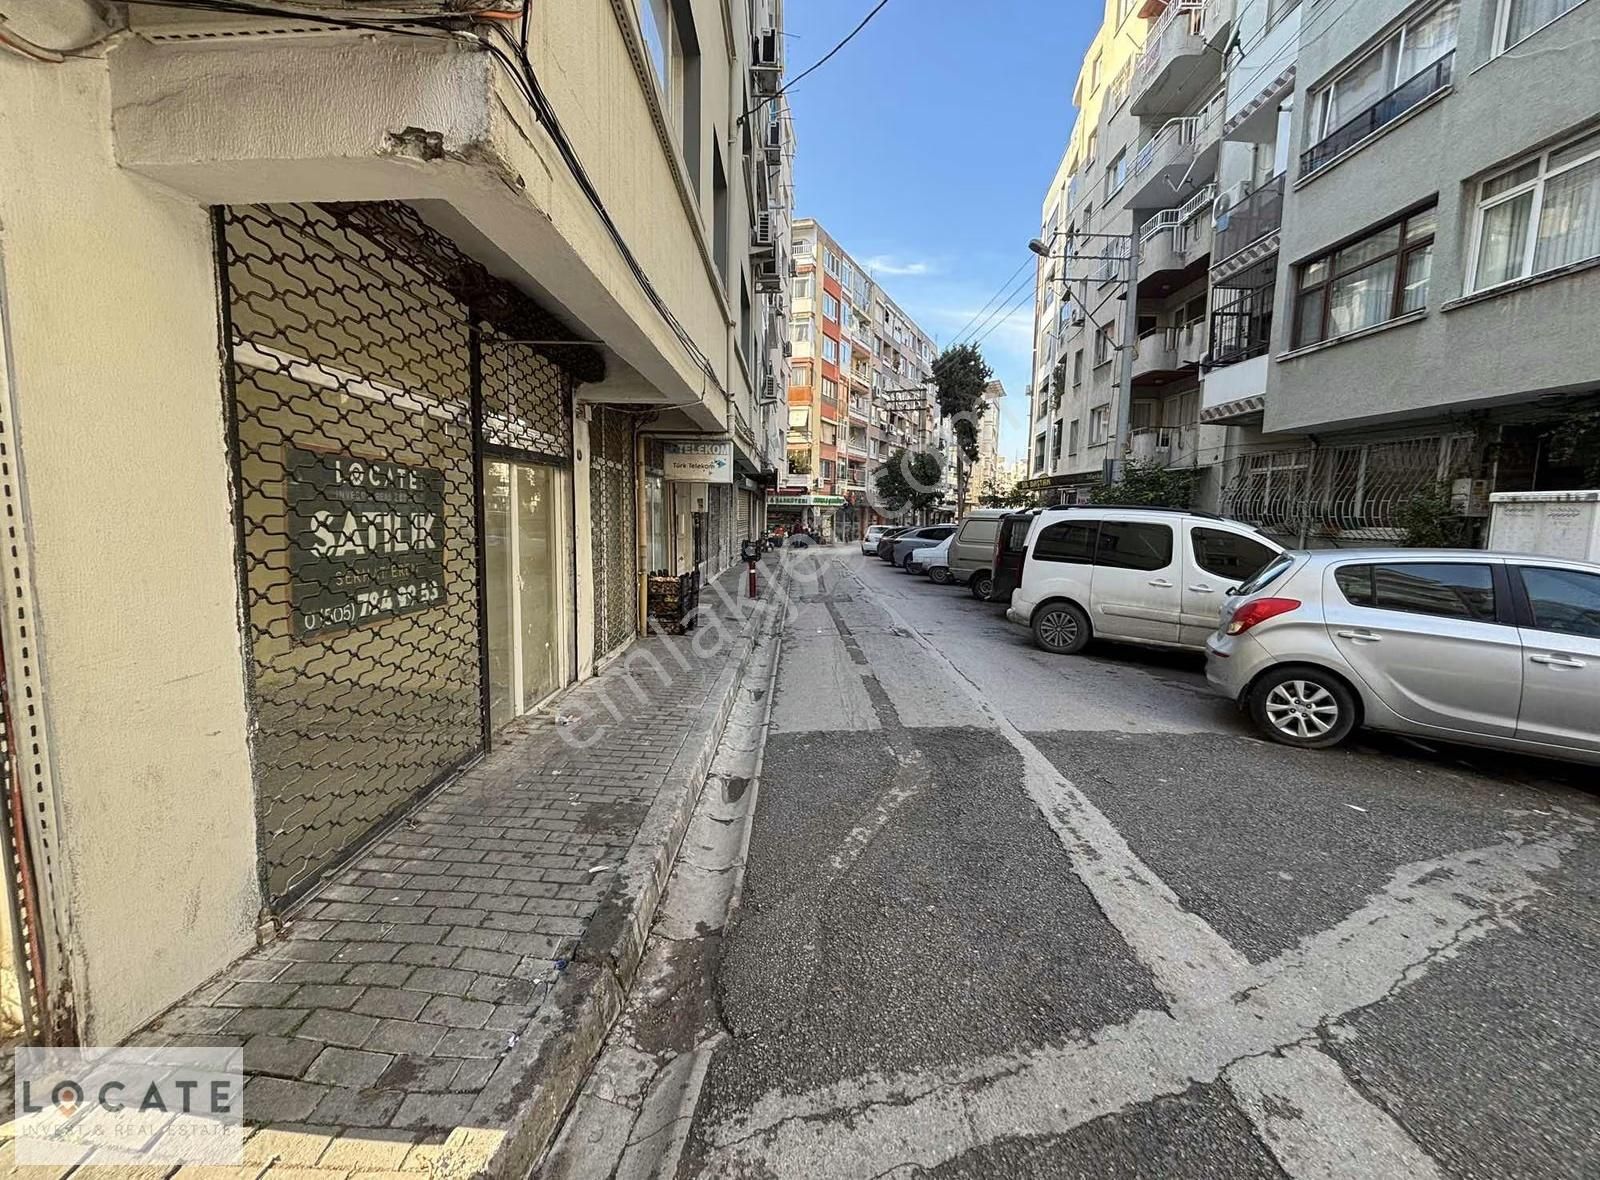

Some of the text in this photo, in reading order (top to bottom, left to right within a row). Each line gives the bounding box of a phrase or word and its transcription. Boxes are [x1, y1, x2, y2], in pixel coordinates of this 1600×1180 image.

[678, 444, 729, 455] TELEKOM
[335, 460, 417, 489] LOCATE
[689, 462, 715, 470] Telekom
[310, 510, 437, 557] SATILIK
